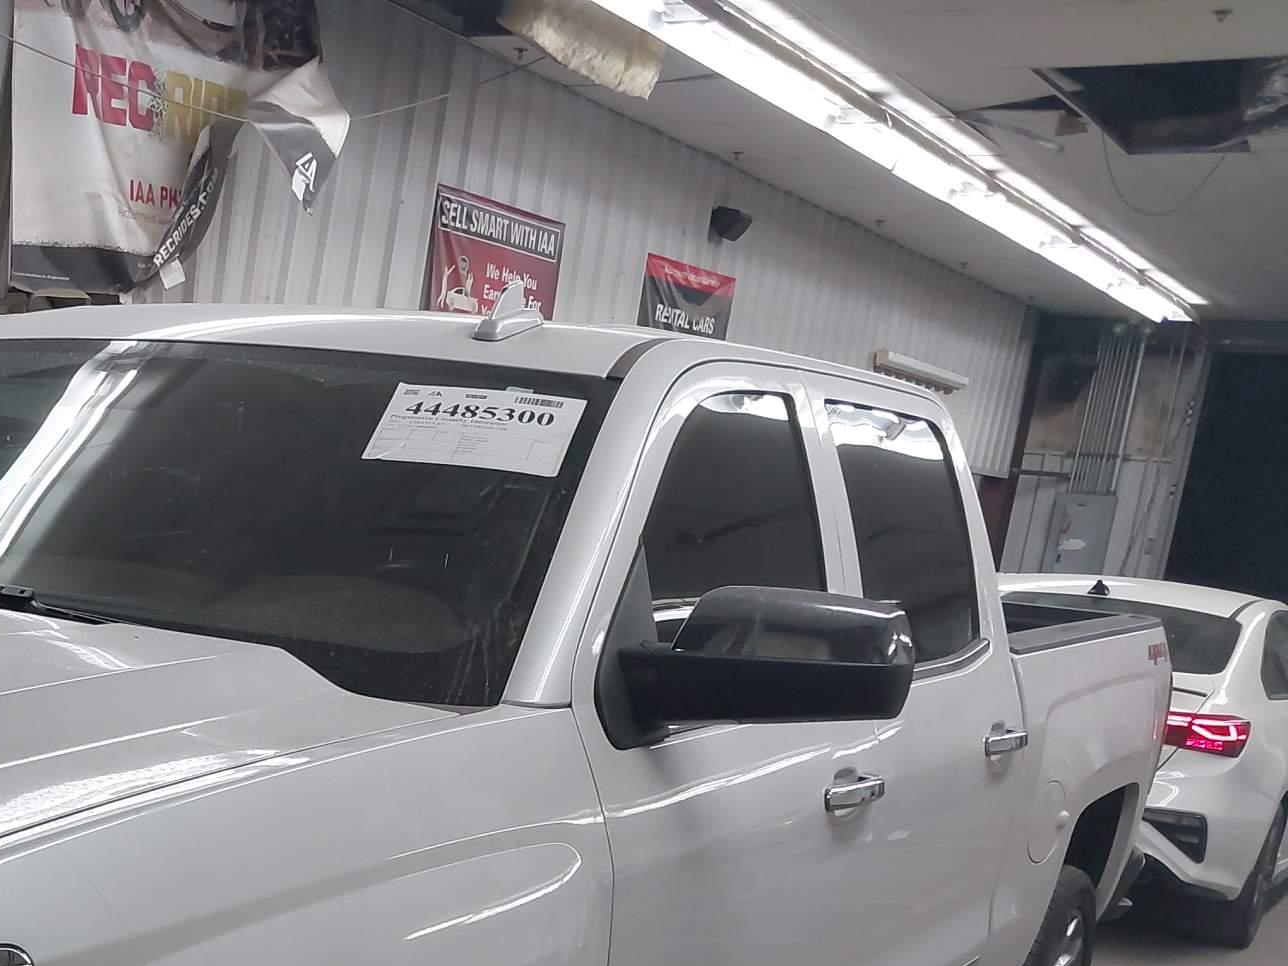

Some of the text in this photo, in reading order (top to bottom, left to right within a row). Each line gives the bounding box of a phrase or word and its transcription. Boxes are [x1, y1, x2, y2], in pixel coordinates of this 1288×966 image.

[72, 43, 156, 132] REC
[129, 179, 156, 206] IAA
[441, 200, 556, 257] SELL SMART WITH IAA
[486, 262, 500, 280] We
[523, 272, 537, 290] You
[527, 295, 542, 312] For
[655, 303, 690, 330] RENTAL
[405, 401, 555, 427] 44485300
